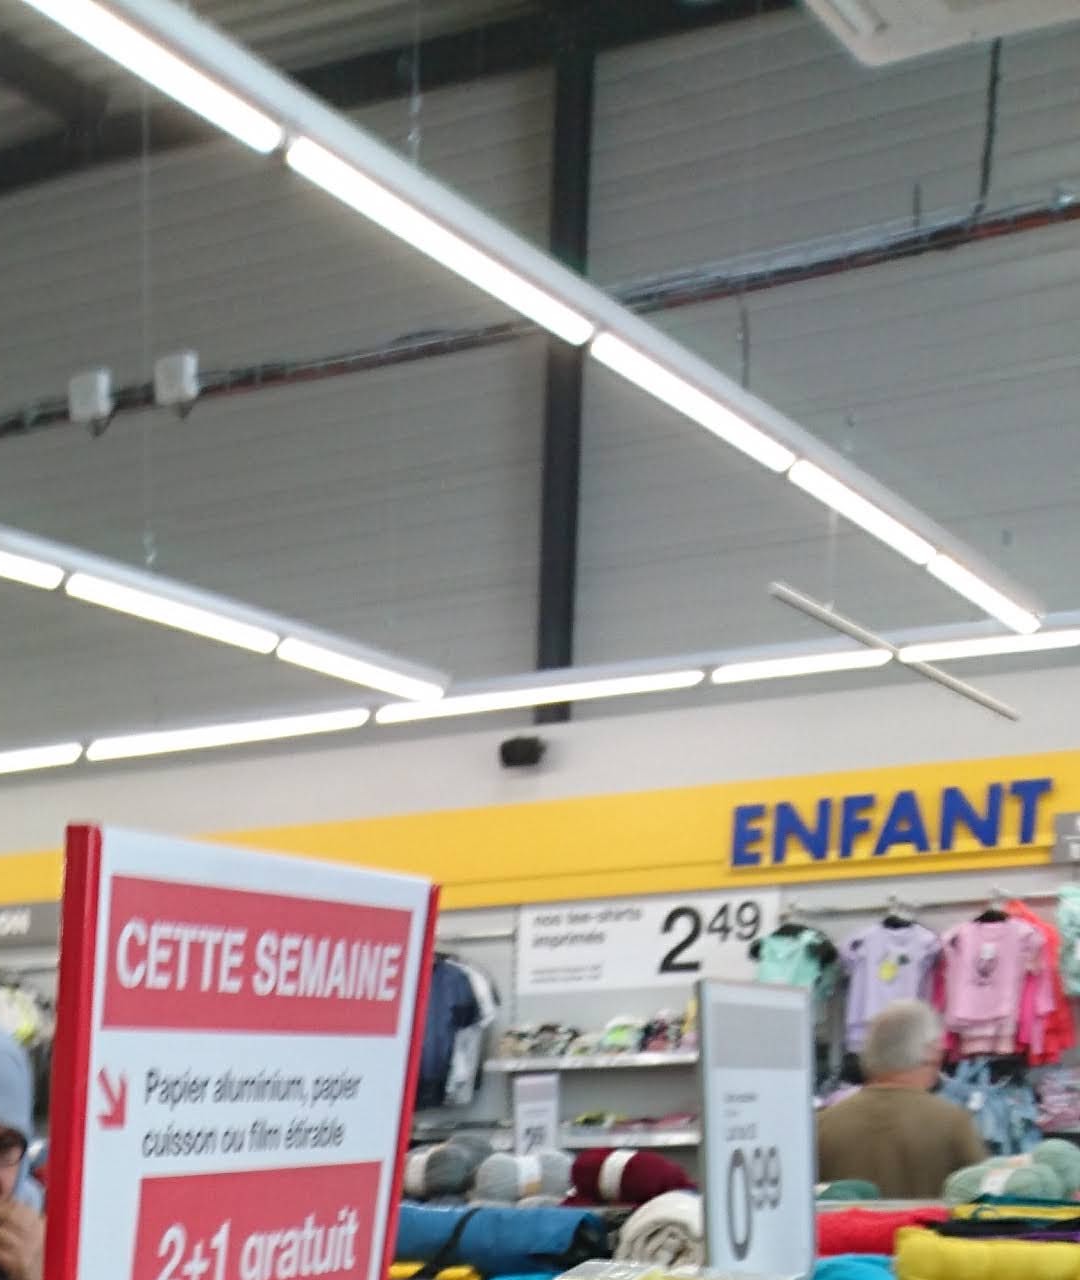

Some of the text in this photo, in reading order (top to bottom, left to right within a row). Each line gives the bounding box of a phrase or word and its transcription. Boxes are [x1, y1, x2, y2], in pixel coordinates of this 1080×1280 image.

[731, 777, 1053, 868] ENFANT
[116, 917, 403, 1003] CETTE SEMAINE
[144, 1068, 362, 1107] Papier aluminium, papier
[141, 1115, 344, 1159] cuisson ou film étirable
